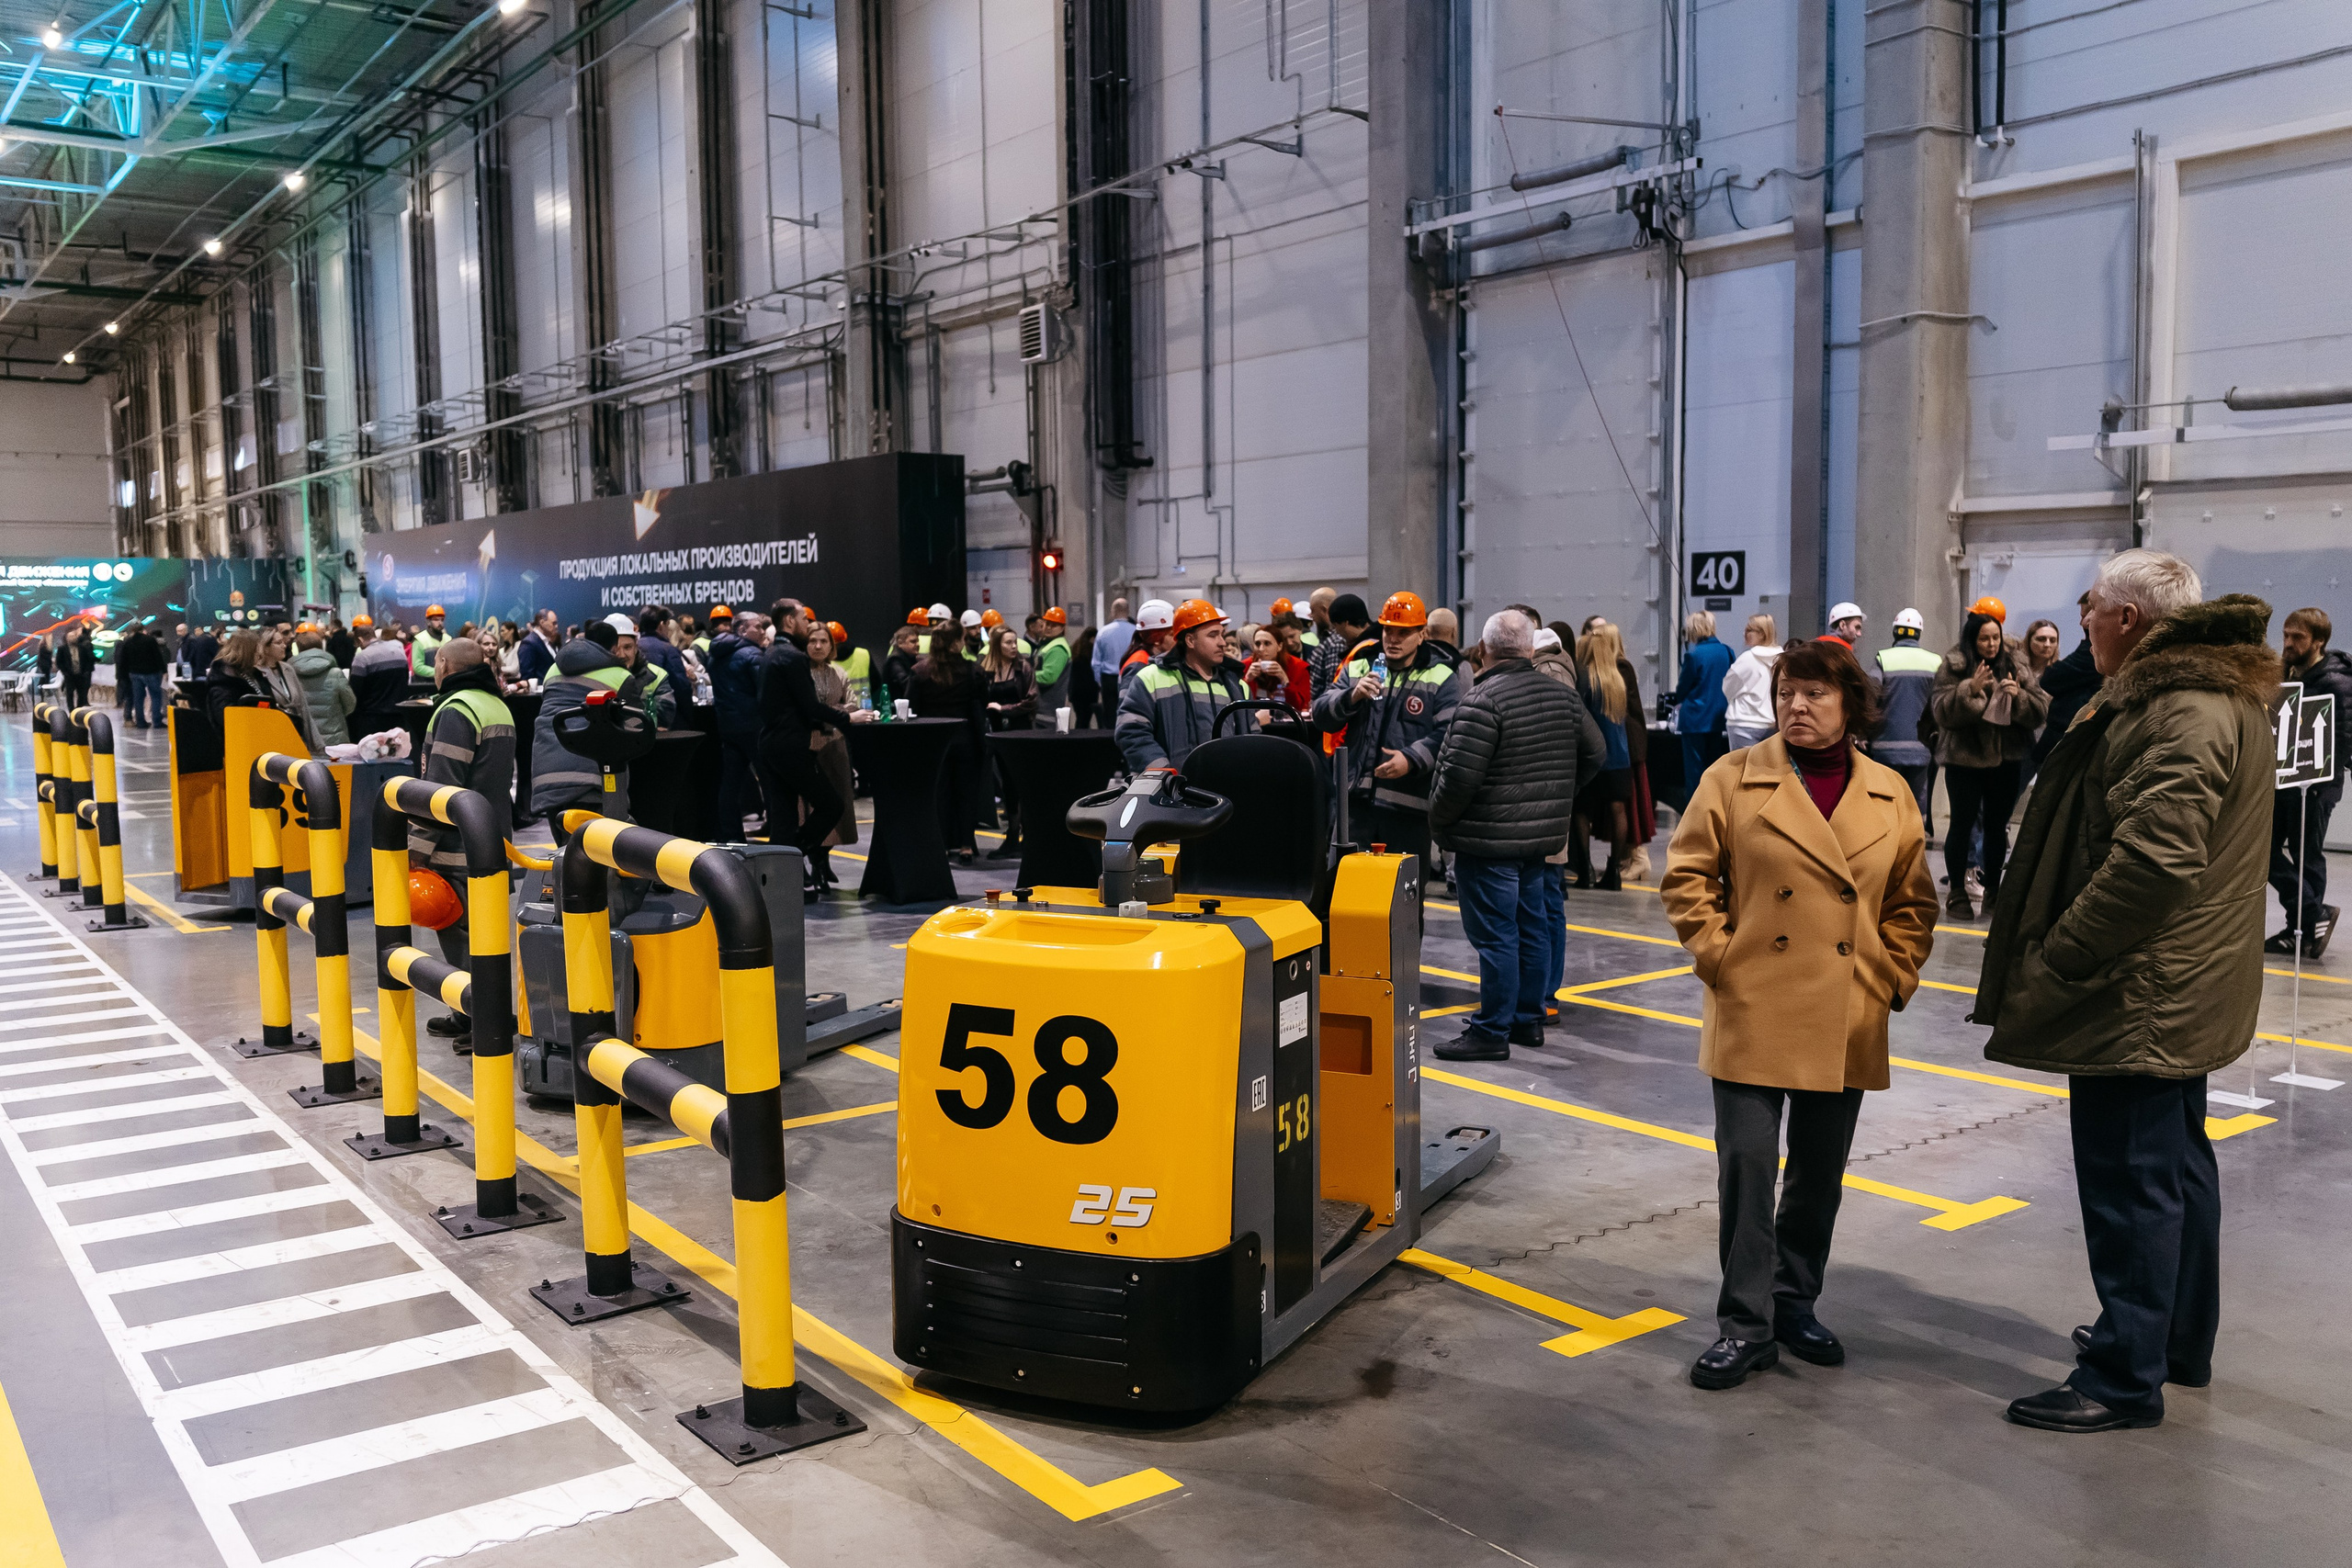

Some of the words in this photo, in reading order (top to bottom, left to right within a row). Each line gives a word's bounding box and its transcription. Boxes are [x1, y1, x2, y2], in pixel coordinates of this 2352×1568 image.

[560, 556, 617, 581] ПРОДУКЦИЯ
[619, 548, 689, 575] ЛОКАЛЬНЫХ
[691, 533, 819, 570] ПРОИЗВОДИТЕЛЕЙ
[1697, 557, 1738, 590] 40
[601, 587, 609, 607] И
[610, 581, 693, 607] СОБСТВЕННЫХ
[695, 579, 755, 605] БРЕНДОВ
[935, 1002, 1119, 1145] 58
[1253, 1078, 1265, 1109] EAC
[1278, 1093, 1309, 1154] 58
[1069, 1183, 1158, 1228] 25
